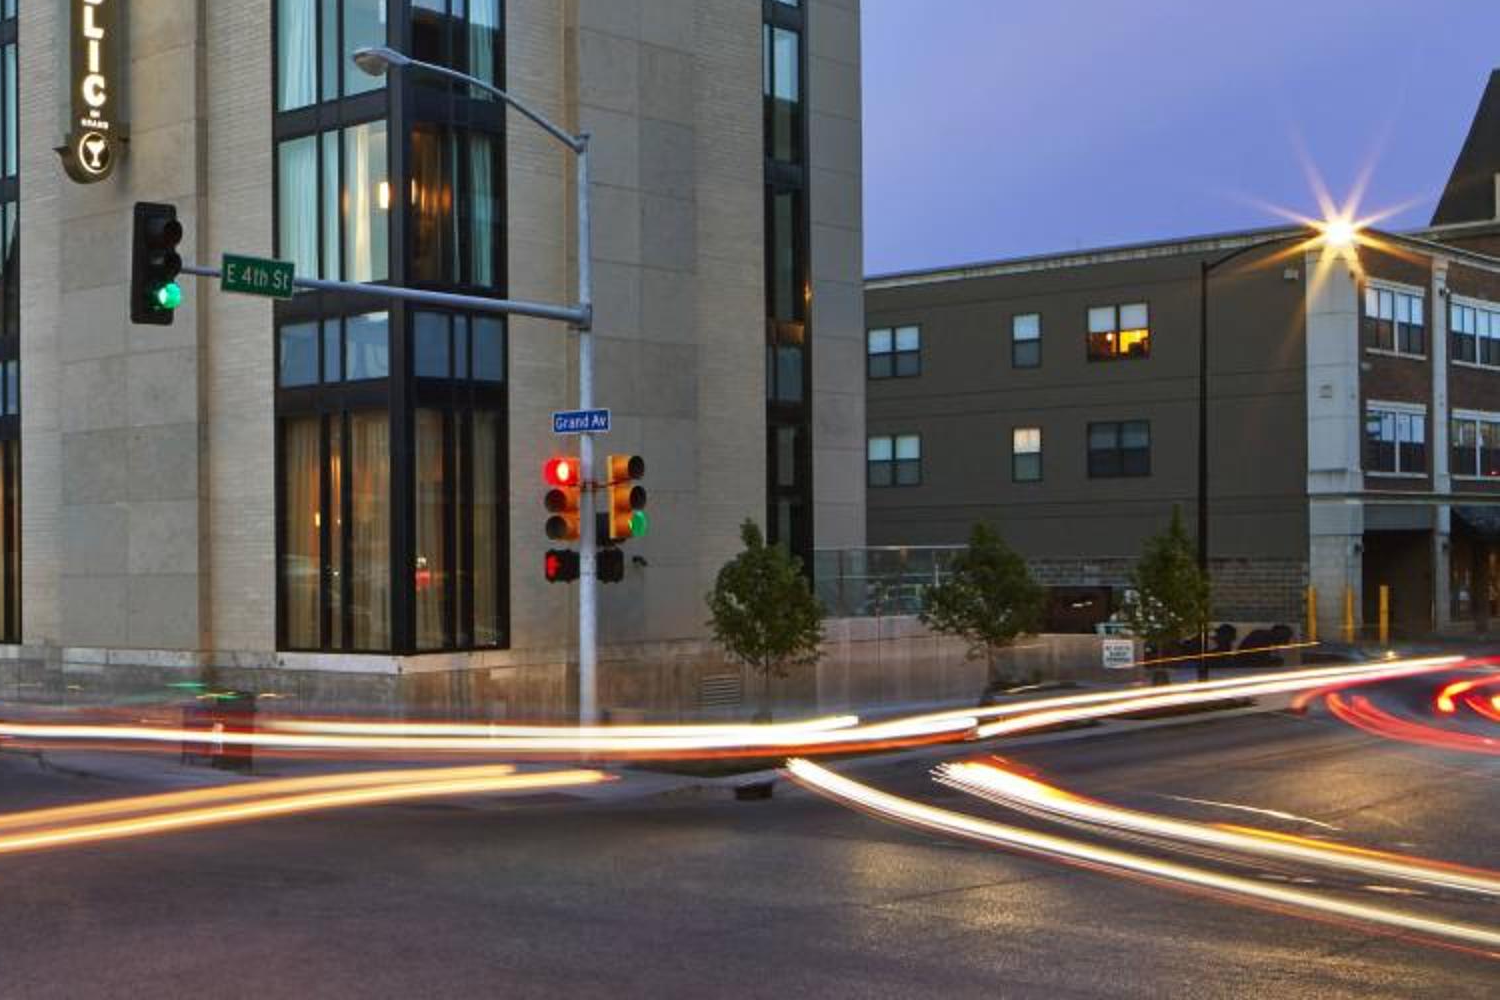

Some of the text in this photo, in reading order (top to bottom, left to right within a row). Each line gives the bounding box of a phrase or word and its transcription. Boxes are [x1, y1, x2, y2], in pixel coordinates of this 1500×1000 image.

[227, 263, 289, 290] E 4th St
[555, 412, 607, 431] Grand Av
